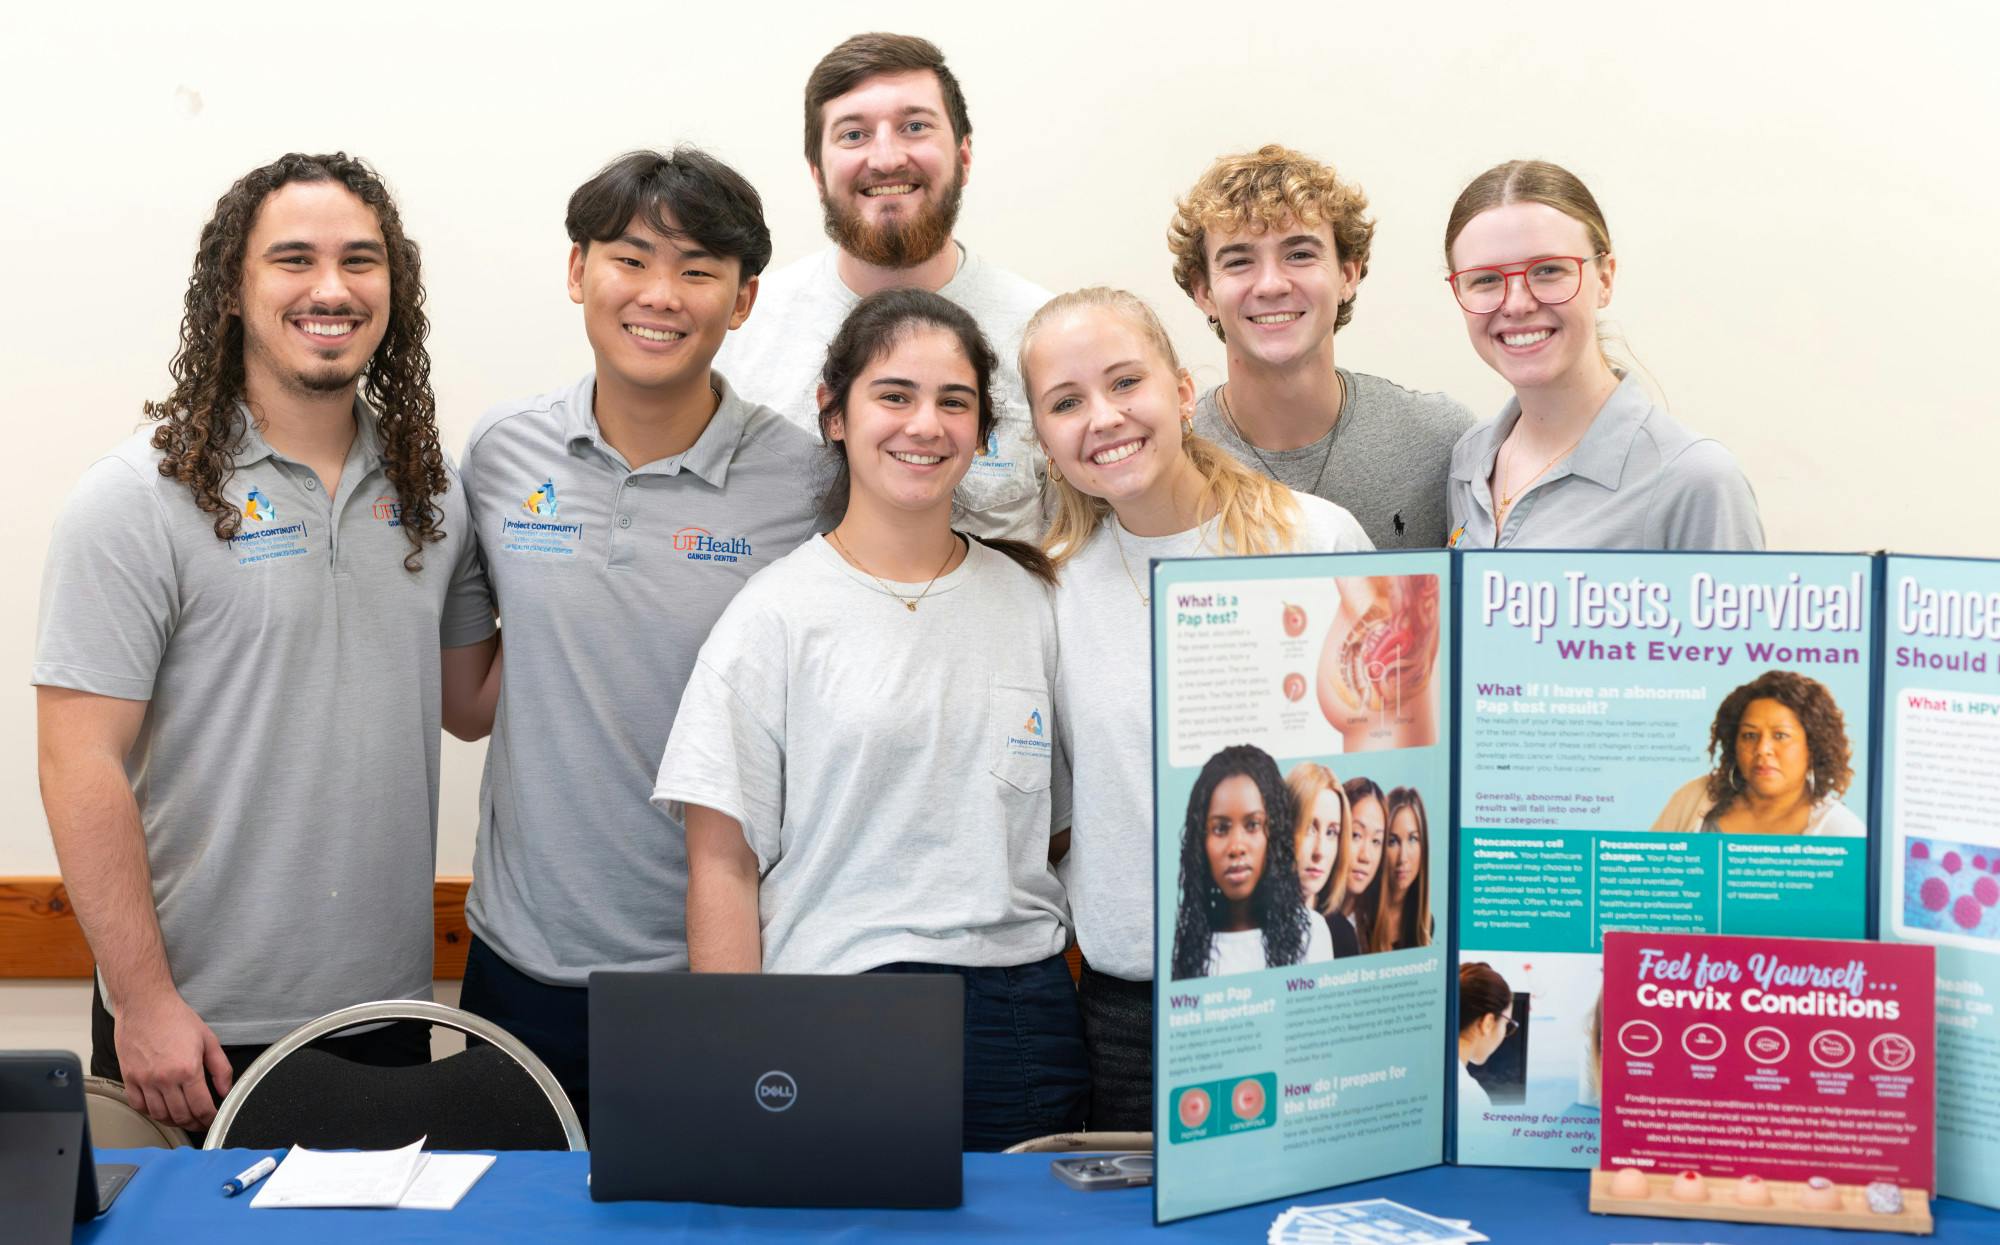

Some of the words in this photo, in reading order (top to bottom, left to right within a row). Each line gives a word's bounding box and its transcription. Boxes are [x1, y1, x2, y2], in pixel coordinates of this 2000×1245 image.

[261, 524, 301, 536] CONTINUITY
[507, 521, 530, 529] Project
[532, 523, 578, 533] CONTINUITY
[672, 535, 752, 556] UFHealth
[687, 553, 711, 561] CANCER
[714, 554, 737, 563] CENTER
[1177, 596, 1213, 608] What
[1216, 594, 1228, 607] is
[1232, 596, 1238, 606] a
[1481, 570, 1558, 643] Pap
[1564, 571, 1683, 637] Tests,
[1690, 572, 1863, 633] Cervical
[1177, 612, 1202, 627] Pap
[1206, 611, 1238, 624] test?
[1557, 639, 1636, 660] What
[1648, 641, 1733, 666] Every
[1745, 642, 1860, 664] Woman
[1896, 647, 1986, 673] Should
[1477, 683, 1522, 696] What
[1527, 684, 1538, 697] if
[1543, 684, 1549, 697] I
[1553, 684, 1593, 698] have
[1598, 687, 1619, 699] an
[1623, 685, 1706, 700] abnormal
[1476, 699, 1508, 714] Pap
[1513, 700, 1545, 713] test
[1551, 700, 1608, 715] result?
[1908, 696, 1947, 712] What
[1953, 700, 1963, 714] is
[1286, 978, 1315, 992] Who
[1318, 969, 1358, 988] should
[1360, 969, 1376, 981] be
[1379, 958, 1438, 979] screened?
[1638, 949, 1692, 982] Feel
[1695, 953, 1741, 989] for
[1170, 994, 1199, 1009] Why
[1203, 991, 1224, 1005] are
[1227, 987, 1252, 1000] Pap
[1636, 983, 1732, 1012] Cervix
[1740, 988, 1900, 1021] Conditions
[1170, 1011, 1201, 1026] tests
[1204, 998, 1275, 1023] important?
[1284, 1084, 1311, 1097] How
[1314, 1079, 1331, 1093] do
[1340, 1069, 1387, 1091] prepare
[1389, 1066, 1407, 1079] for
[761, 1085, 792, 1097] DELL
[1284, 1100, 1305, 1115] the
[1307, 1094, 1338, 1113] test?
[1483, 1112, 1539, 1124] Screening
[1542, 1114, 1558, 1123] for
[1512, 1128, 1521, 1137] If
[1524, 1128, 1563, 1139] caught
[1566, 1130, 1596, 1140] early,
[1572, 1145, 1583, 1153] of
